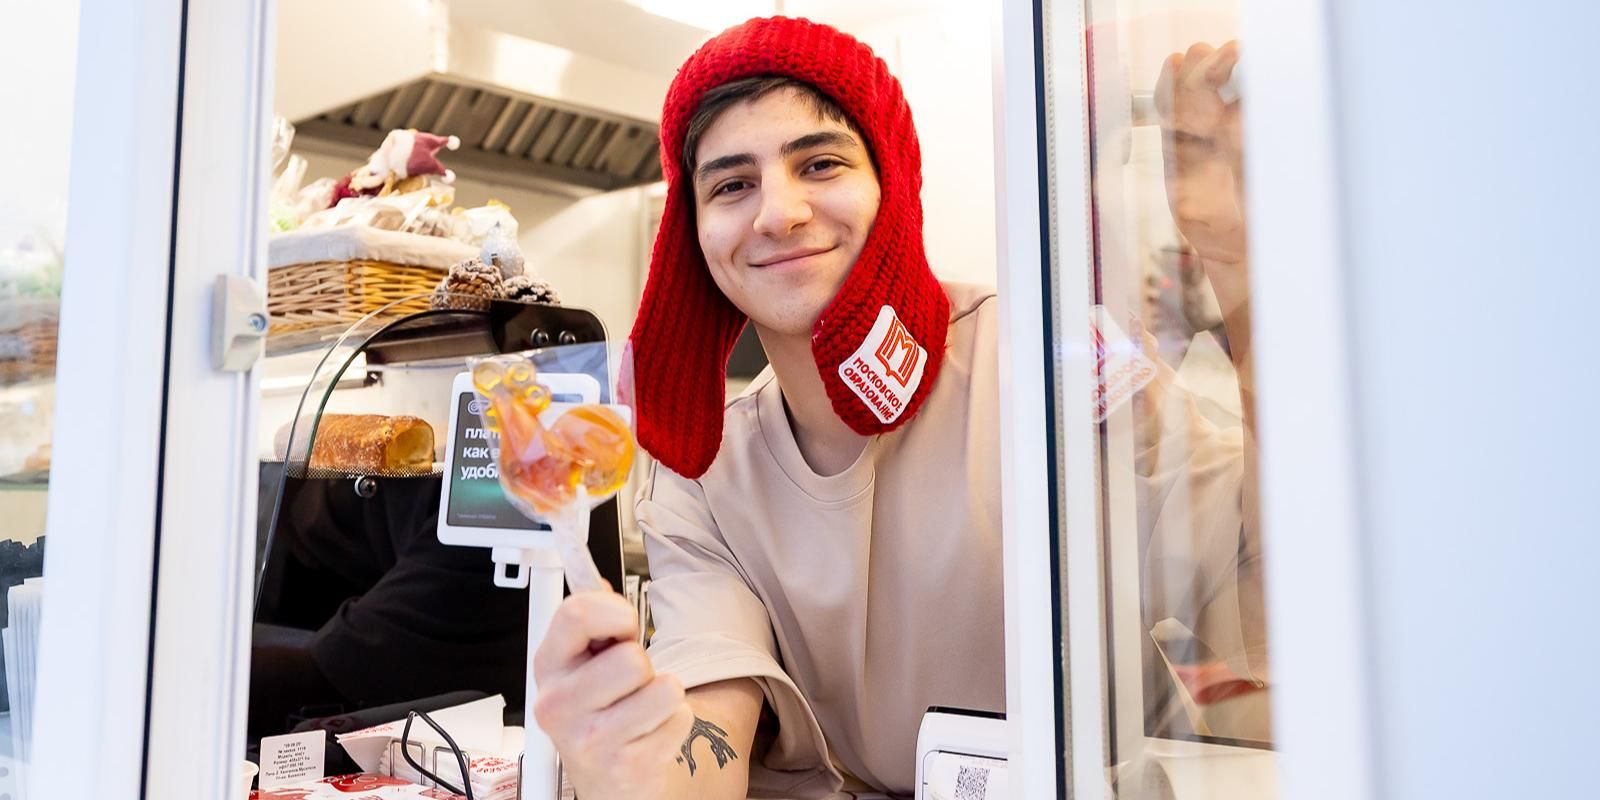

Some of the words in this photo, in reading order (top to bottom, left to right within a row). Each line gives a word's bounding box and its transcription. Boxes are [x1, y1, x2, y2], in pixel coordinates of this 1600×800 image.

[843, 367, 894, 421] ОБРАЗОВАНИЕ
[852, 356, 903, 412] МОСКОВСКОЕ
[463, 447, 489, 458] как
